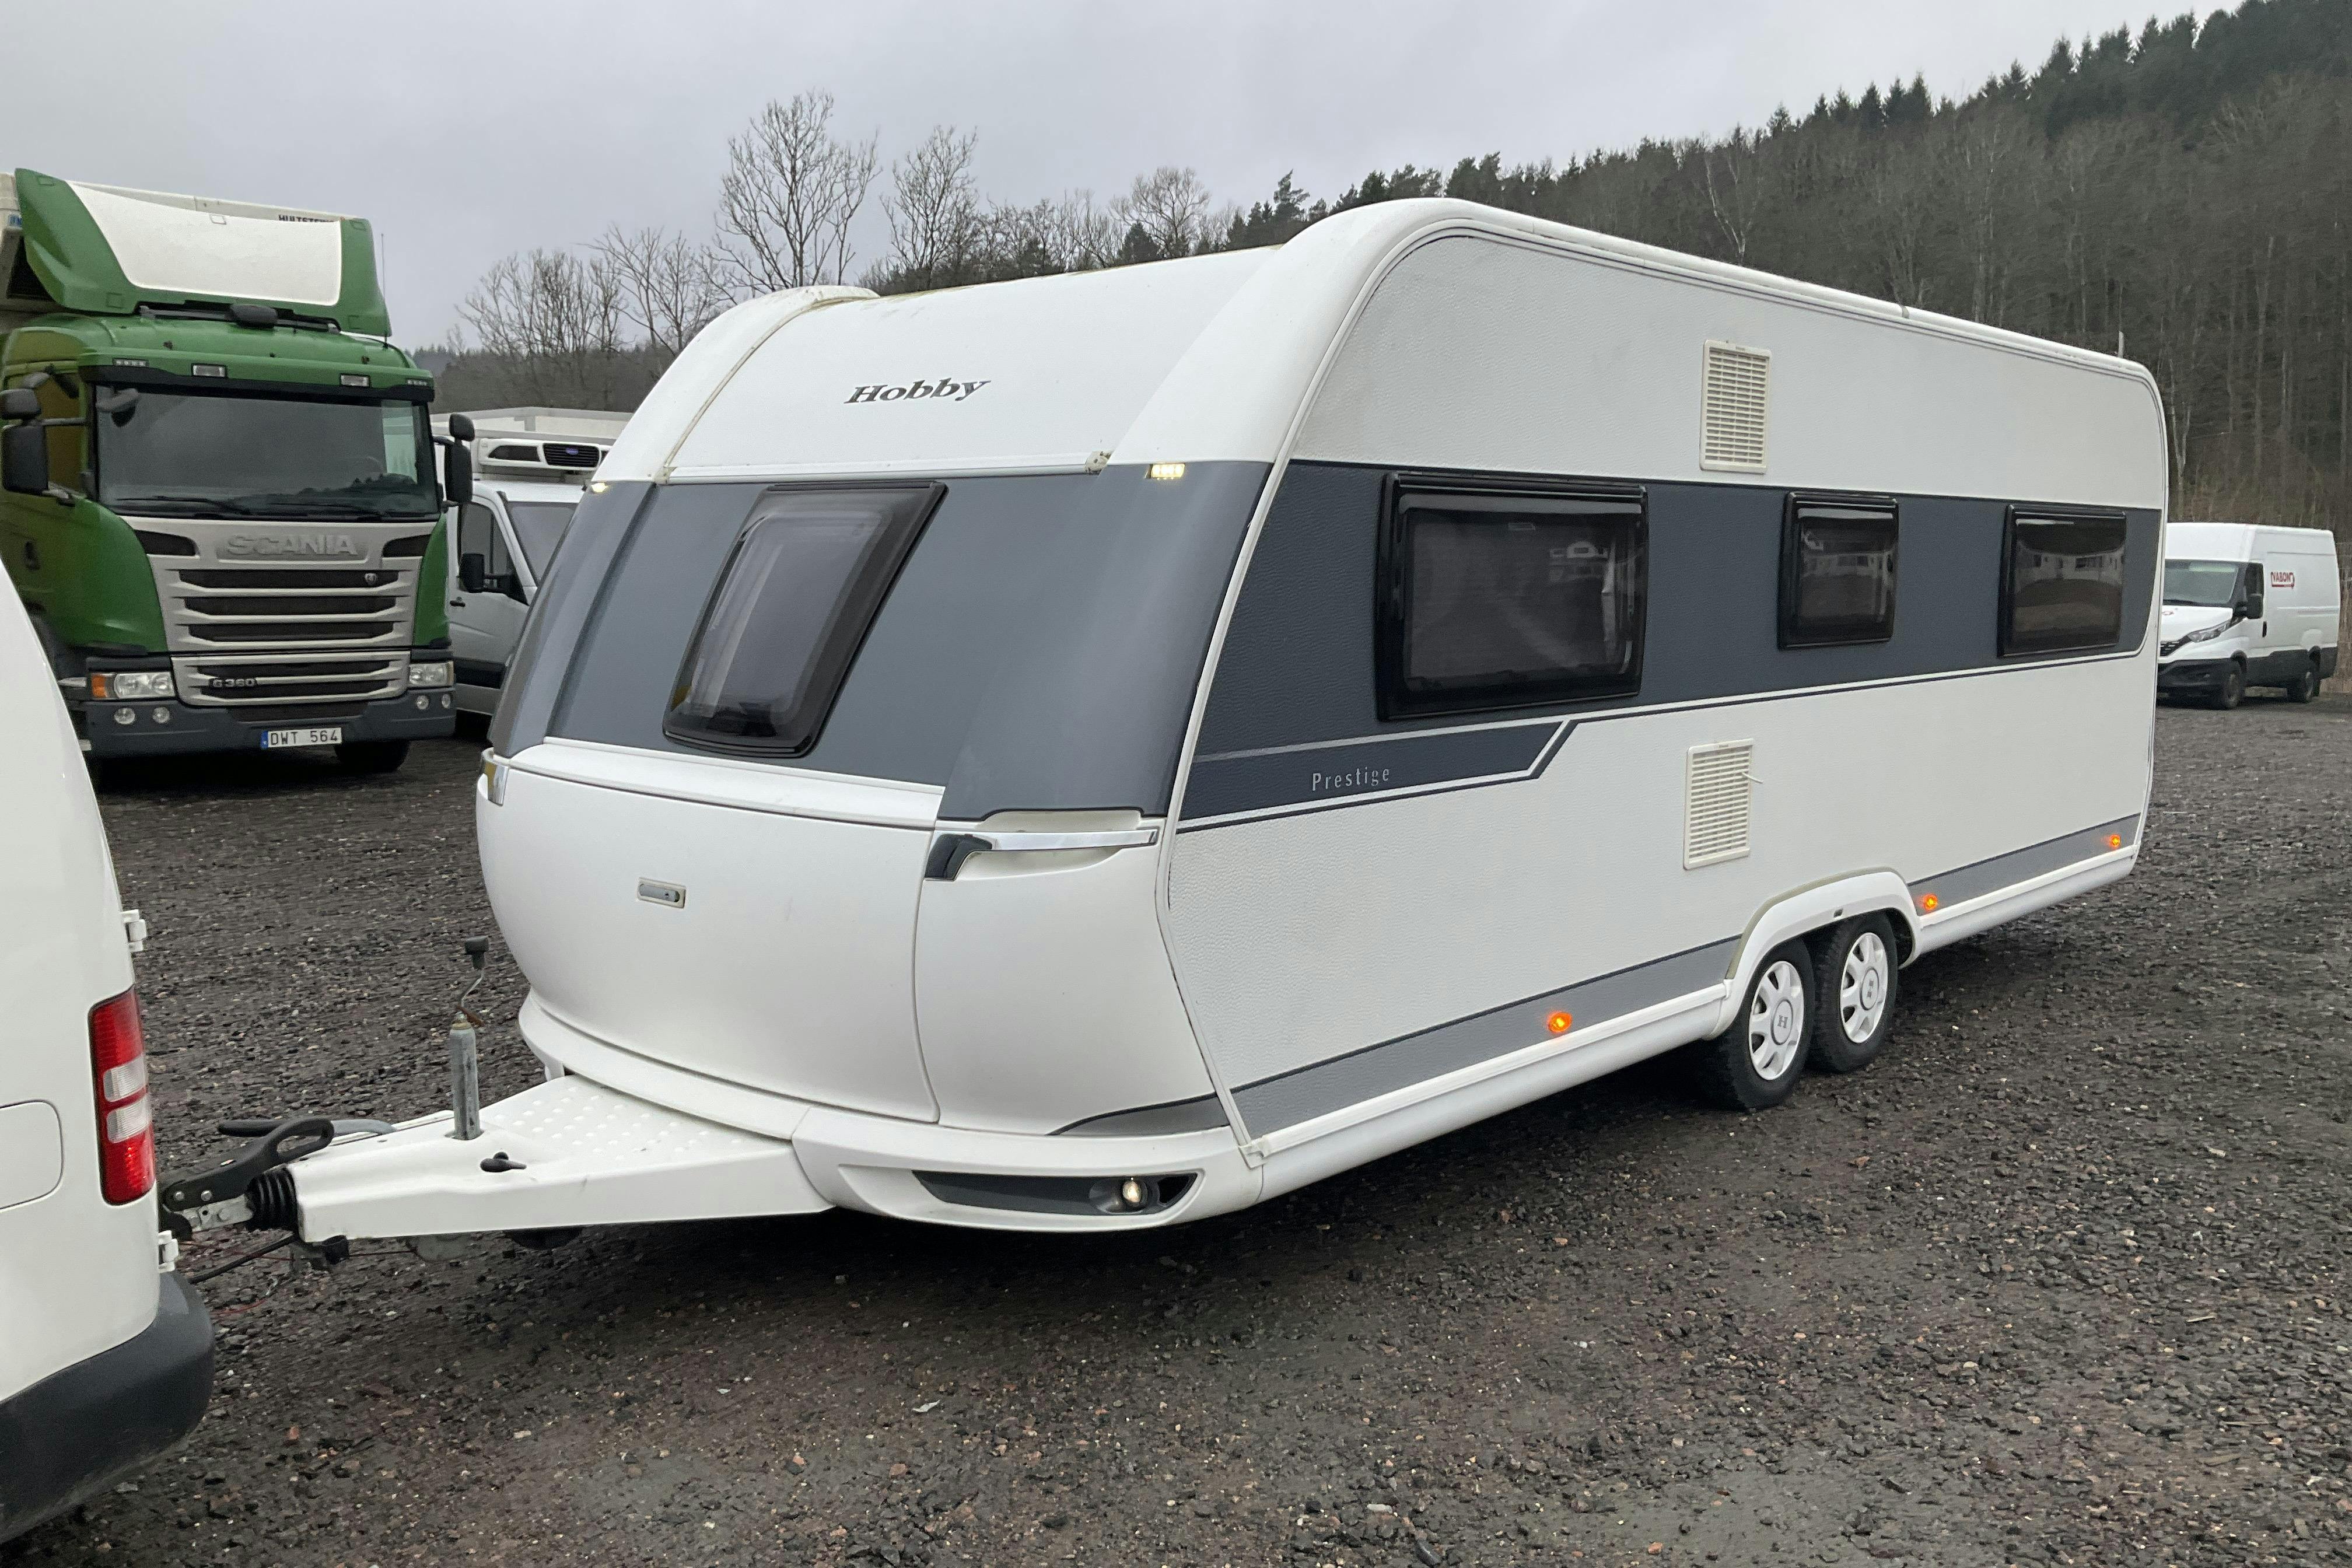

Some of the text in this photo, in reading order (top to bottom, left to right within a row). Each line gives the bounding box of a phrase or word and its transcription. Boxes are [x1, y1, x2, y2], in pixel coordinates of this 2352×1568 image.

[844, 377, 991, 404] Hobby
[227, 534, 358, 556] SCANIA
[213, 678, 256, 688] G360
[270, 729, 338, 746] DWT 564
[1312, 766, 1390, 791] Prestige
[1777, 1014, 1788, 1028] H
